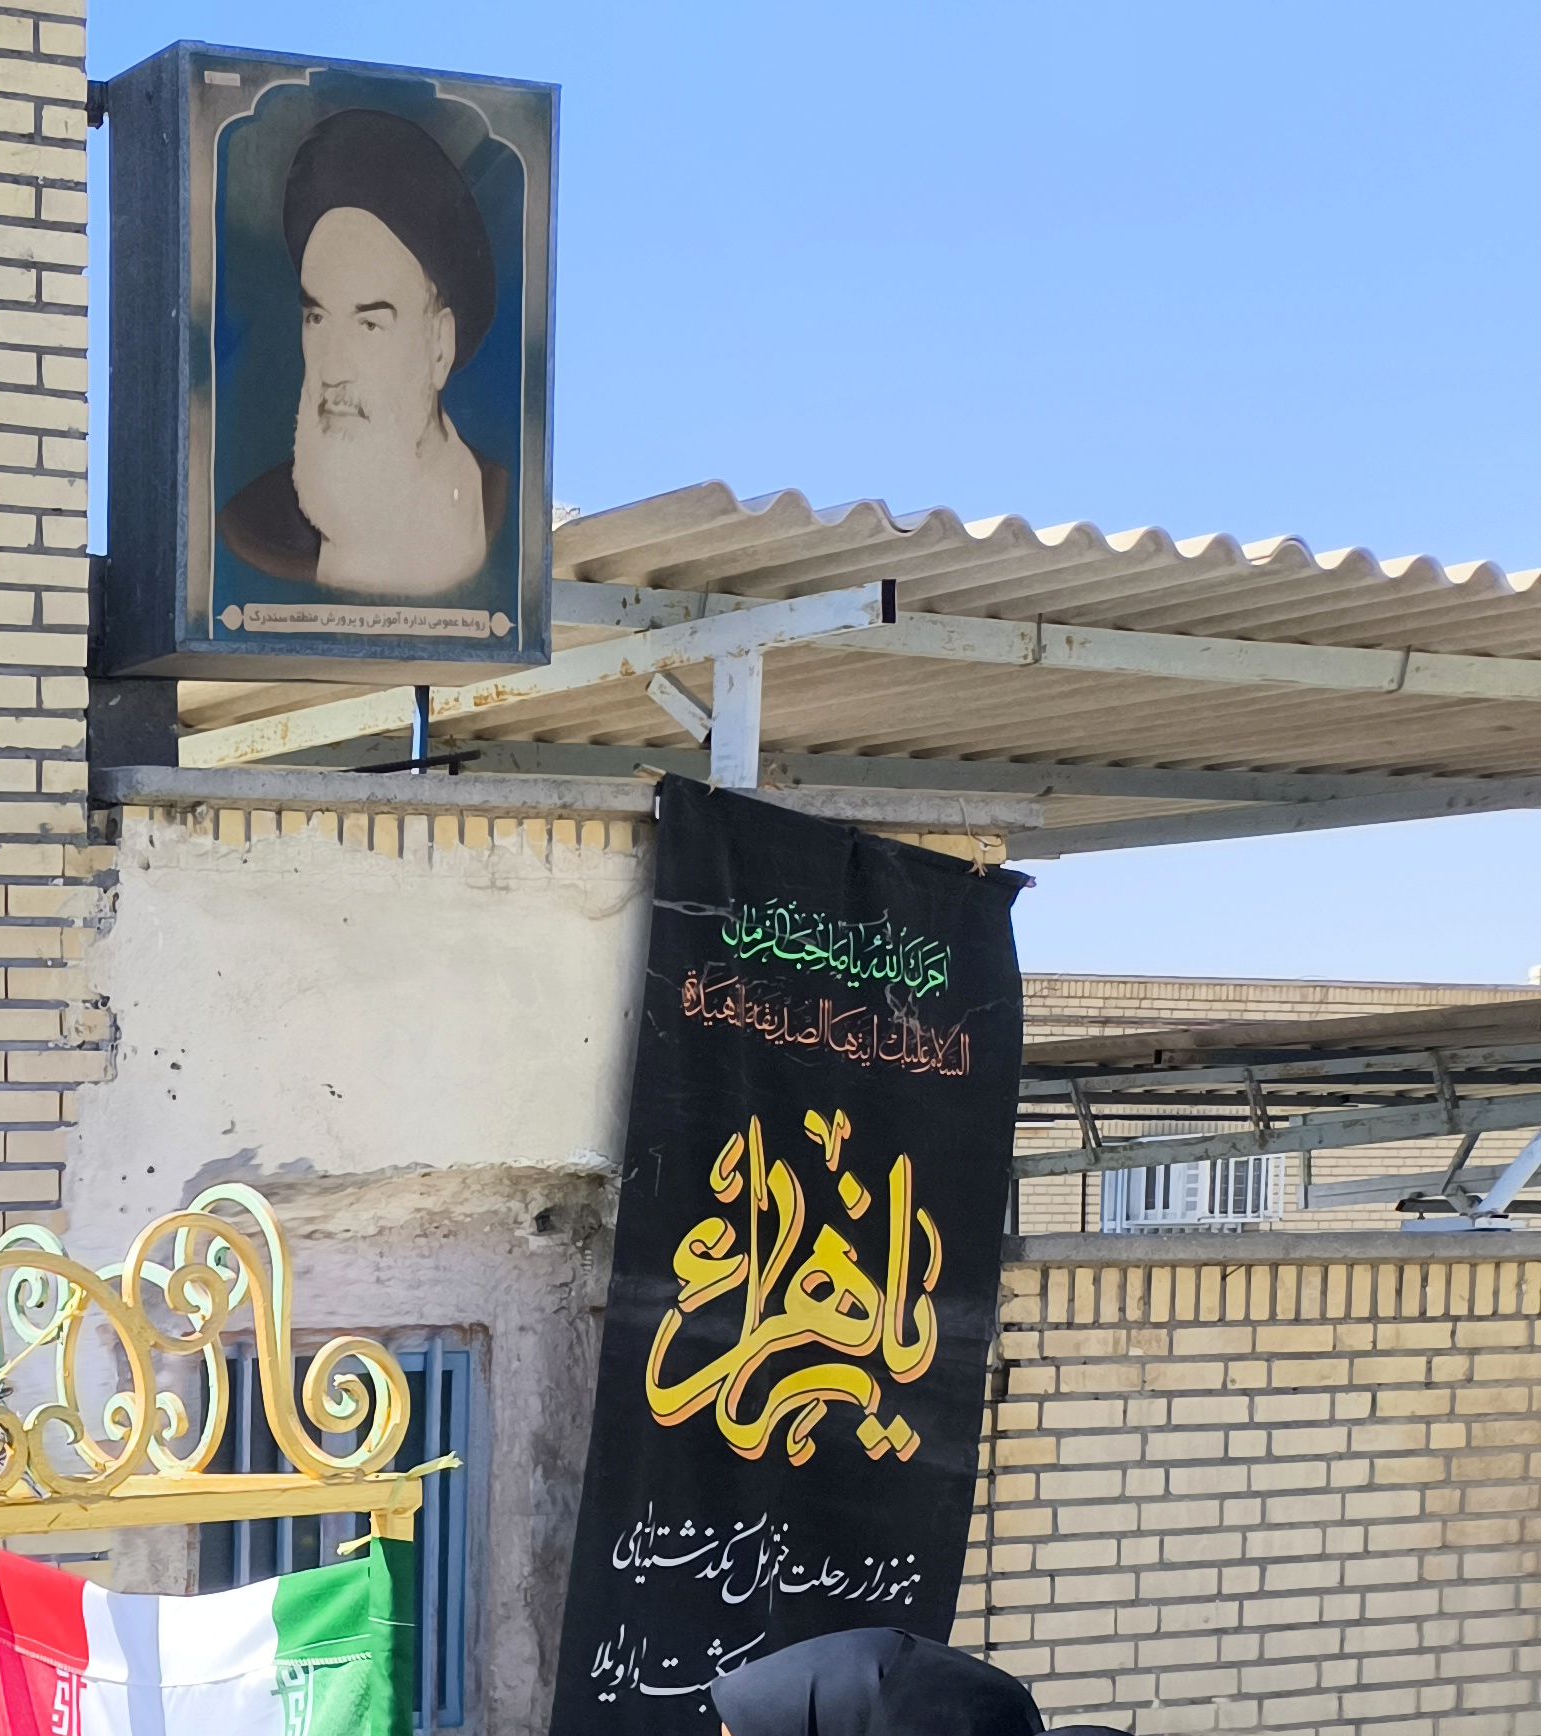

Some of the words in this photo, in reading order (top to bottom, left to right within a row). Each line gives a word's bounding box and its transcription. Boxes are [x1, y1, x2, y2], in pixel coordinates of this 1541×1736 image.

[358, 616, 365, 627] و
[366, 611, 402, 629] آموزش
[403, 615, 427, 629] اداره
[428, 619, 459, 630] عمومی
[779, 1555, 850, 1597] رحلت
[844, 1556, 885, 1601] از
[866, 1553, 921, 1605] هنوز
